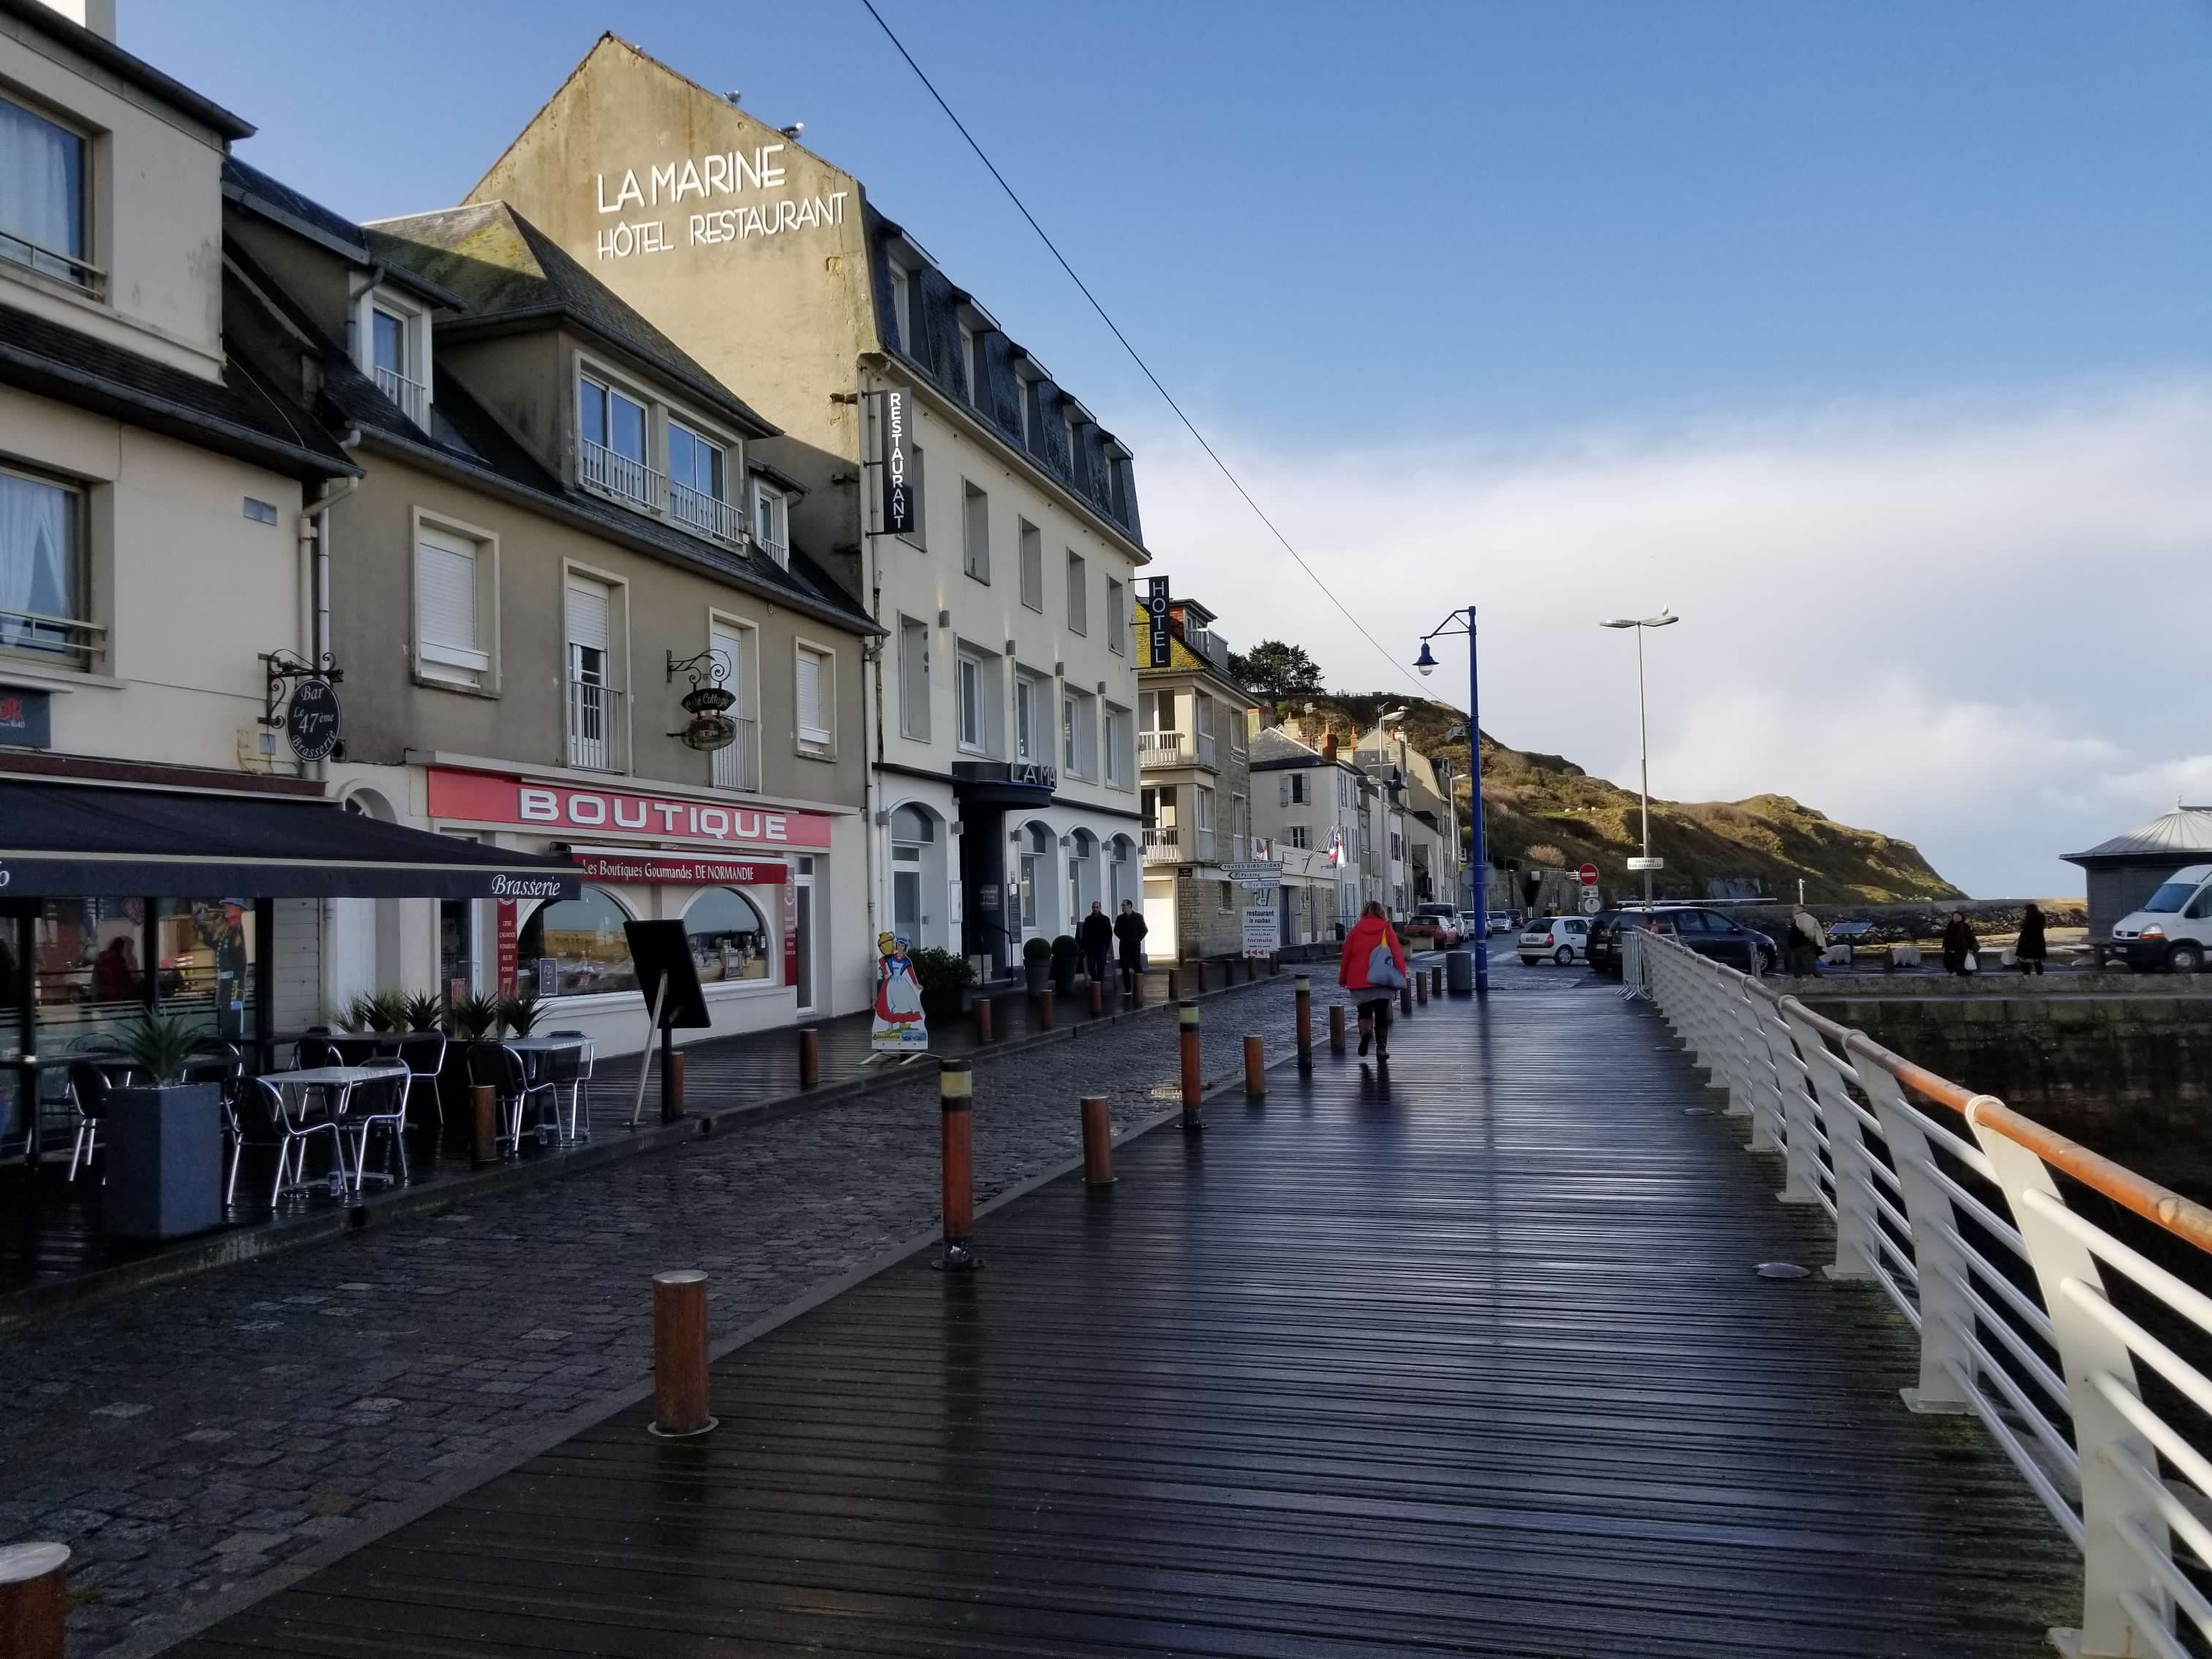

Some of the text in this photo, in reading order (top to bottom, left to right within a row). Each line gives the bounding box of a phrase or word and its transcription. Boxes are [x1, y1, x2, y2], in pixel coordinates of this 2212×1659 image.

[597, 143, 786, 214] LA MARINE
[596, 192, 849, 260] HÔTEL RESTAURANT
[889, 392, 906, 529] RESTAURANT
[1152, 580, 1166, 663] HOTEL
[301, 685, 325, 701] Bar
[293, 707, 305, 718] Le
[293, 730, 336, 758] Brasserie
[1011, 762, 1037, 785] LA
[520, 788, 788, 840] BOUTIQUE
[583, 859, 754, 881] Les Boutiques Gourmandes DE NORMANDIE
[492, 874, 561, 896] Brasserie
